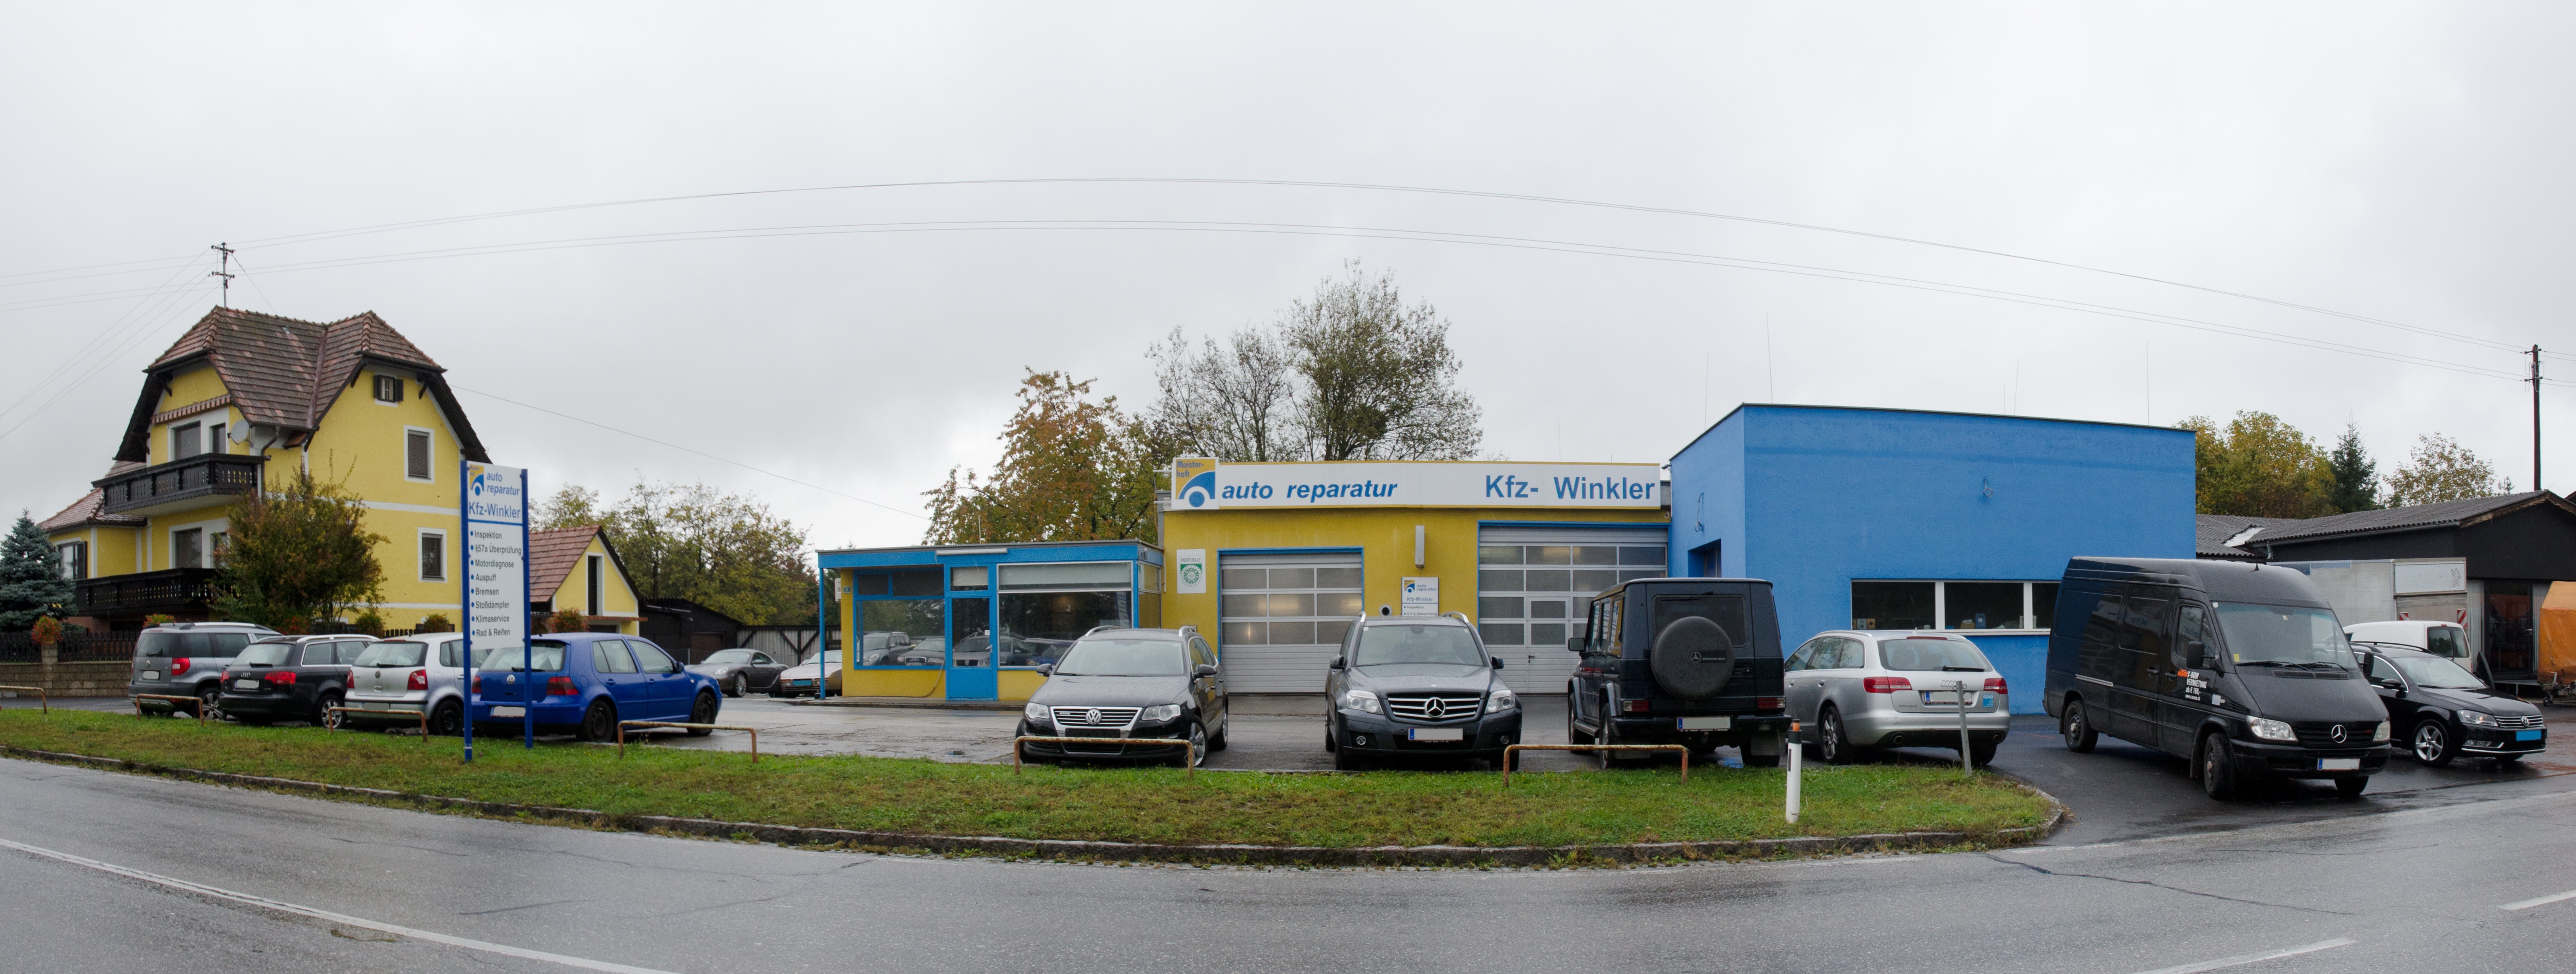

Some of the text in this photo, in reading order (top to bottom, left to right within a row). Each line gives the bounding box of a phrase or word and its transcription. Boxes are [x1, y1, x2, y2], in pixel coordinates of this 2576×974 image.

[486, 472, 502, 482] auto
[487, 485, 520, 496] reparatur
[1222, 480, 1398, 503] auto reparatur
[1486, 475, 1655, 500] Kfz- Winkler
[469, 501, 520, 518] Kfz-Winkler
[474, 530, 502, 540] Inspektion
[475, 543, 522, 555] §57a Überprüfung
[475, 559, 514, 569] Motordiagnose
[476, 573, 496, 583] Auspuff
[476, 601, 509, 611] Stoßdämpfer
[476, 614, 510, 623] Klimaservice
[476, 629, 487, 637] Rad
[2187, 671, 2200, 679] X-BOW
[2187, 678, 2207, 689] VERMIETUNG
